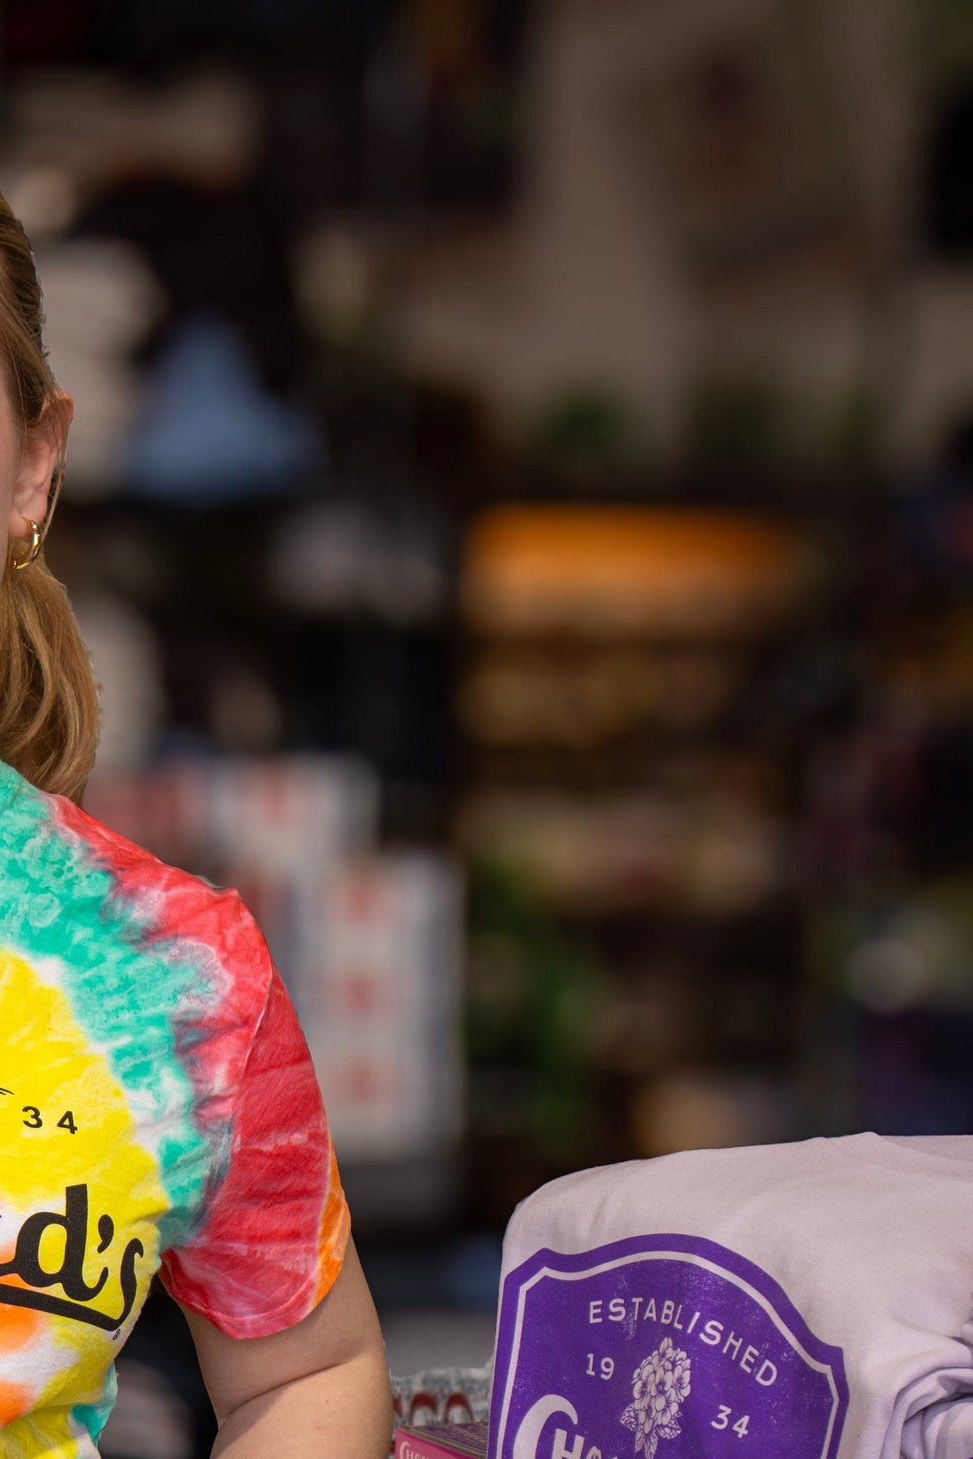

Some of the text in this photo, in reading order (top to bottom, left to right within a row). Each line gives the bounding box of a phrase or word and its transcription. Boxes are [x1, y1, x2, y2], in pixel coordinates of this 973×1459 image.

[20, 1105, 79, 1135] 34
[589, 1297, 778, 1387] ESTABLISHED
[585, 1352, 616, 1381] 19
[710, 1404, 751, 1439] 34
